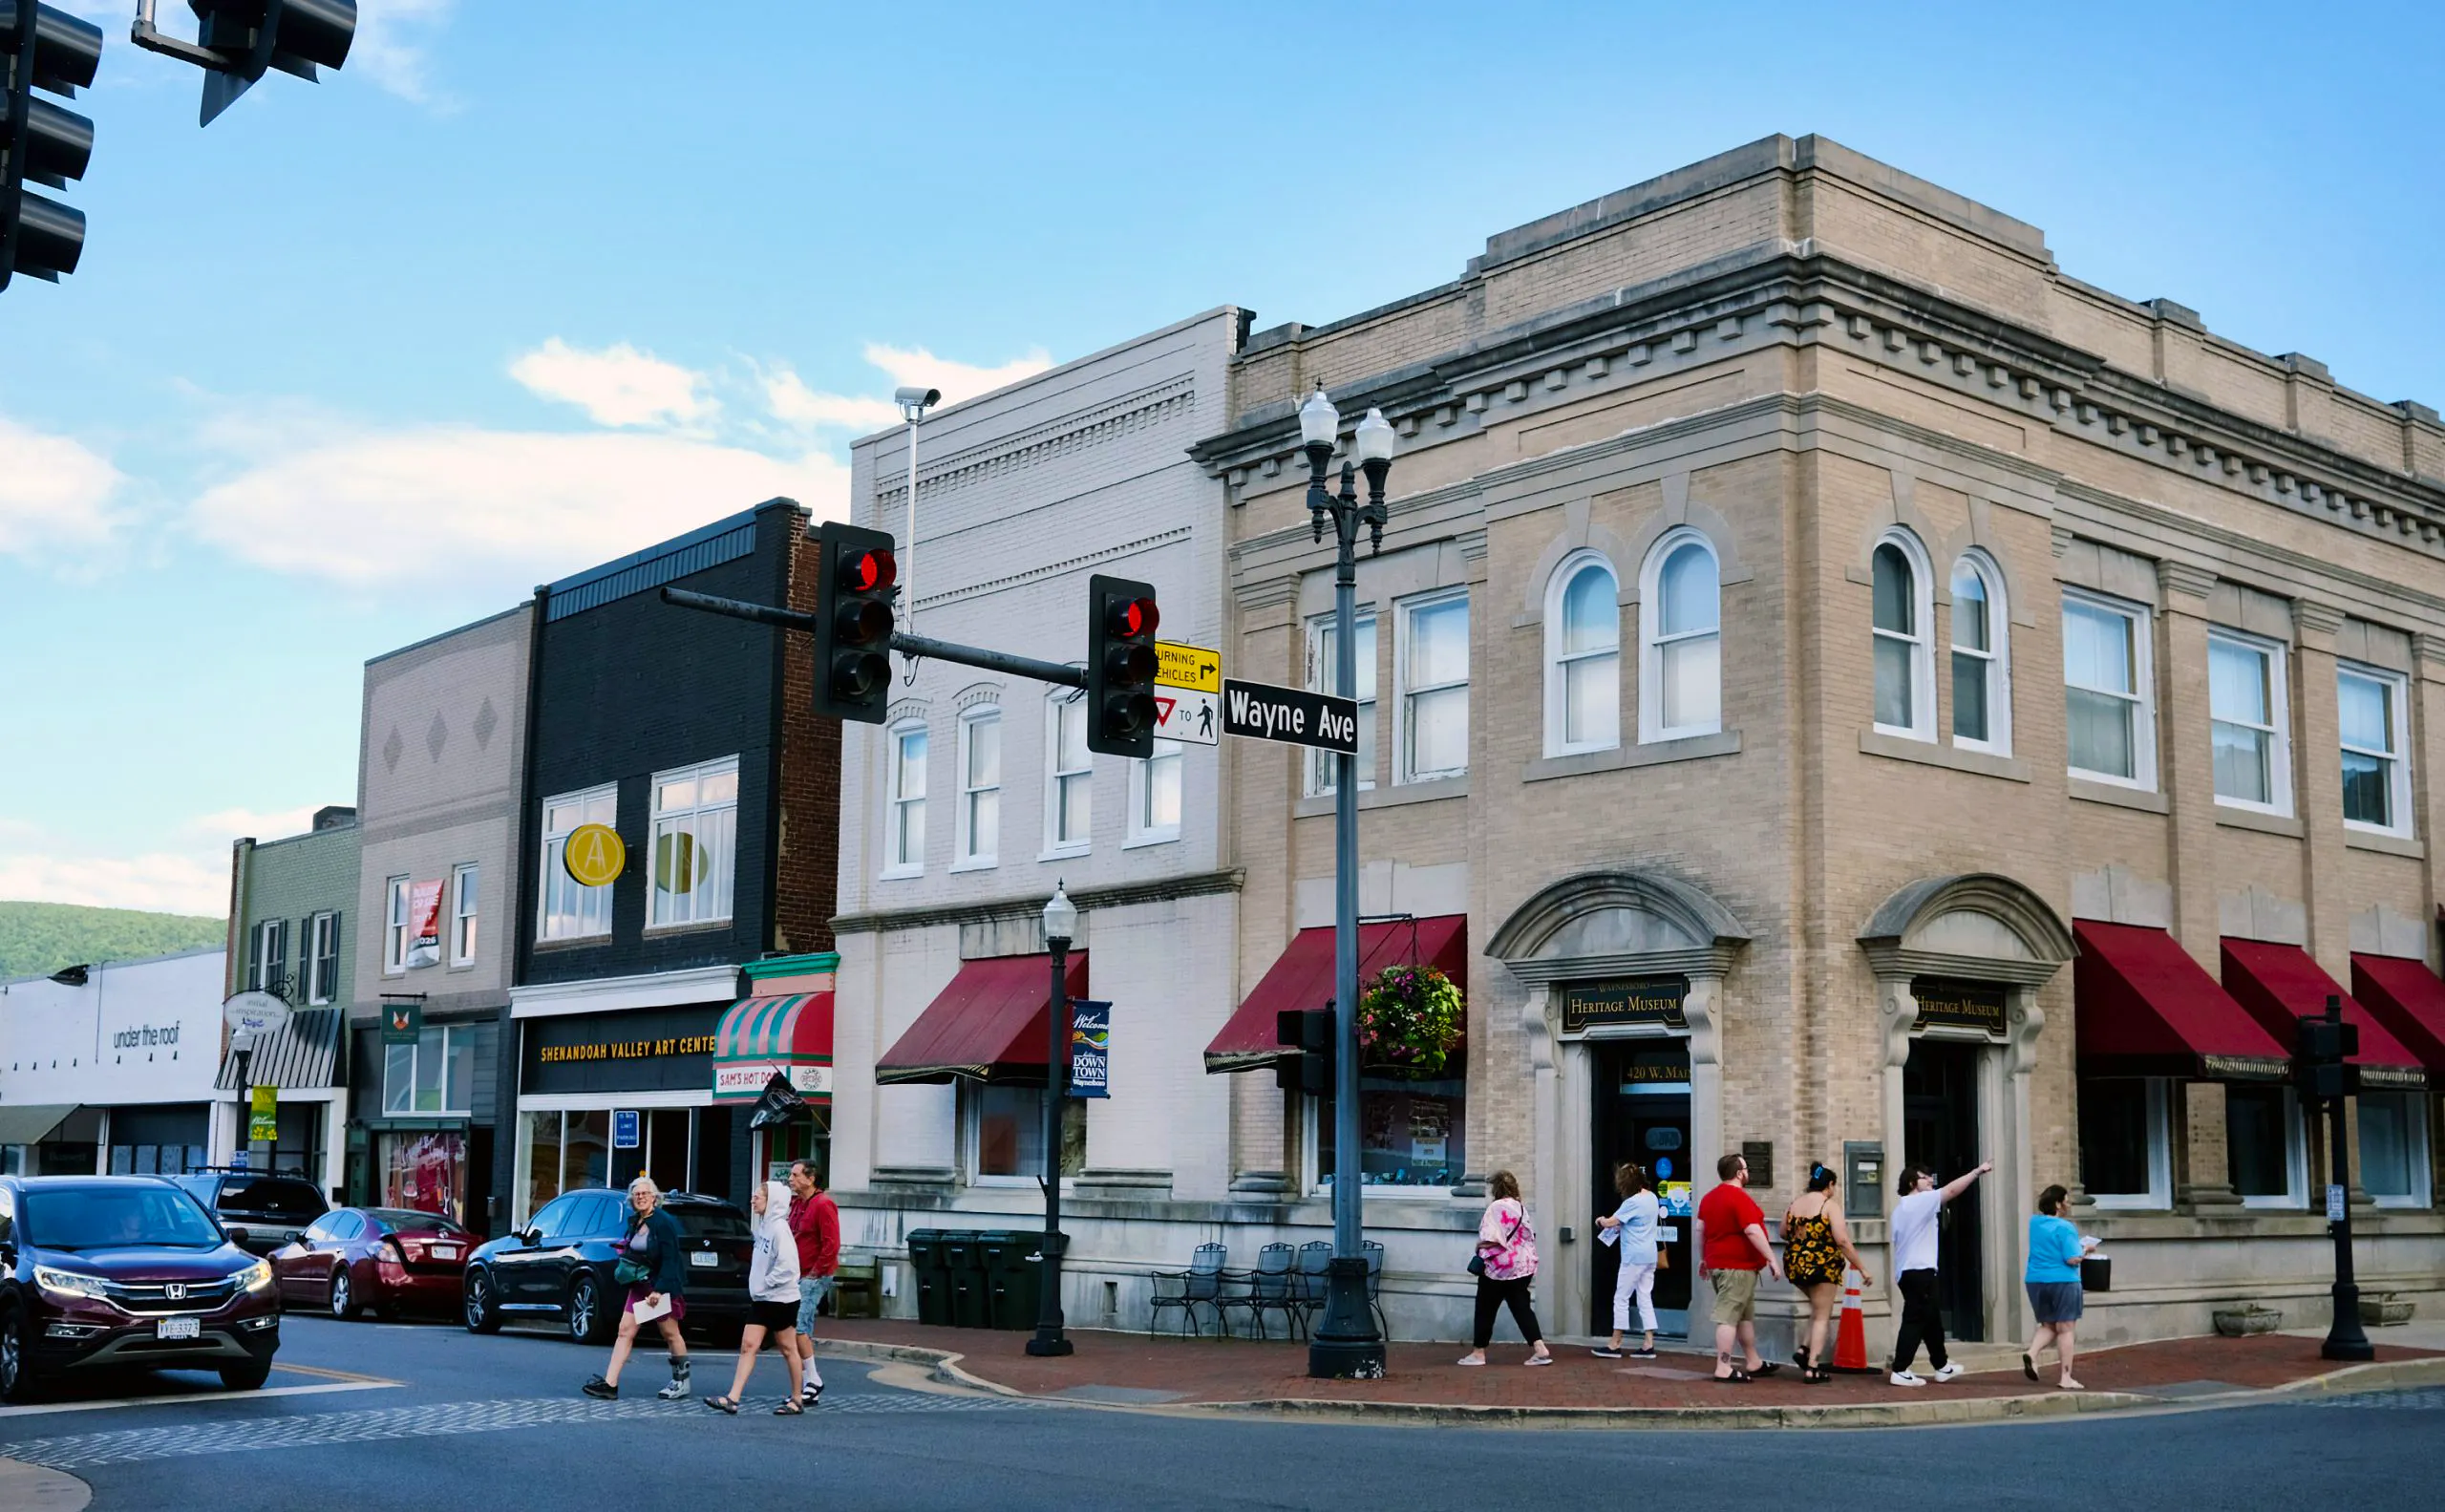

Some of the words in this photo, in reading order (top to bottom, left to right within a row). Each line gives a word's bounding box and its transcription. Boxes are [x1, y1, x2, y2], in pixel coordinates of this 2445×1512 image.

[1156, 650, 1195, 666] URNING
[1157, 668, 1196, 683] EHICLES
[1180, 710, 1192, 722] TO
[1229, 690, 1305, 738] Wayne
[1318, 705, 1354, 743] Ave
[1597, 982, 1650, 993] WAYNESBORO
[1571, 998, 1625, 1013] HERITAGE
[1627, 995, 1677, 1012] MUSEUM
[1916, 995, 1960, 1013] HERITAGE
[1962, 998, 1999, 1017] MUSEUM
[1073, 1012, 1109, 1030] Welcome
[114, 1026, 140, 1049] under
[142, 1024, 158, 1046] the
[159, 1020, 180, 1045] roof
[541, 1044, 607, 1062] SHENANDOAH
[610, 1041, 650, 1058] VALLEY
[654, 1038, 676, 1055] ART
[679, 1035, 715, 1054] CENTE
[1074, 1056, 1106, 1068] DOWN
[720, 1073, 742, 1086] SAM'S
[744, 1073, 760, 1085] HOT
[1073, 1067, 1106, 1078] TOWN
[1627, 1066, 1646, 1079] 420
[1648, 1066, 1663, 1078] W.
